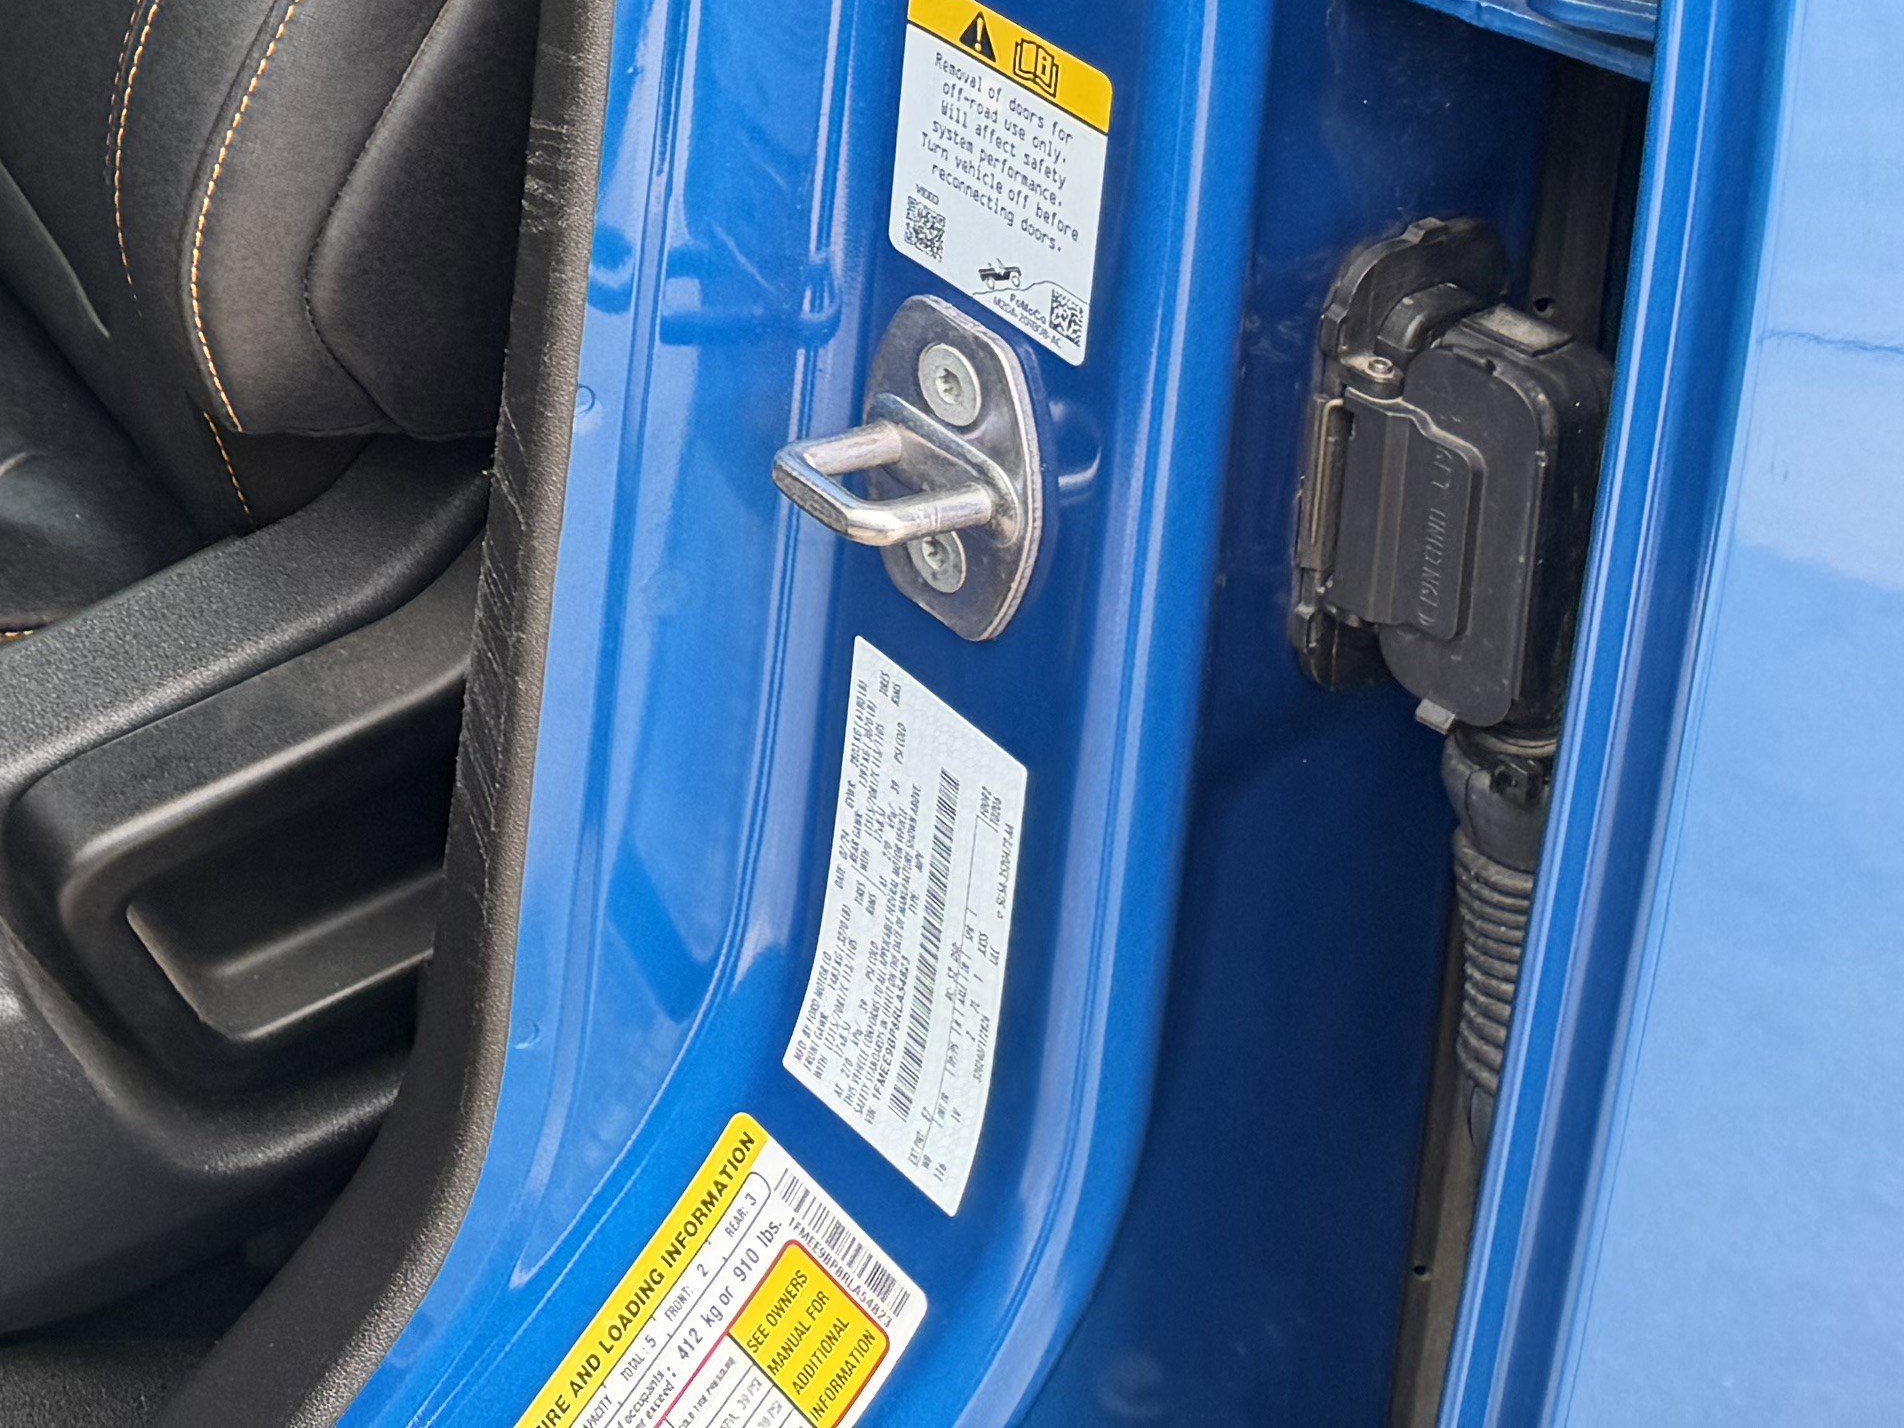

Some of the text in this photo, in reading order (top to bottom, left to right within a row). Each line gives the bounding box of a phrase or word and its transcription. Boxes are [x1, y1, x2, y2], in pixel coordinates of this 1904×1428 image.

[935, 52, 1073, 143] Removal of doors for
[942, 82, 1066, 164] off-road use only.
[932, 120, 1062, 206] system performance.
[941, 99, 1066, 190] Will affect safety
[922, 131, 1078, 242] Turn vehicle off before
[932, 164, 1061, 252] reconnecting doors.
[905, 815, 917, 850] SHOWN
[898, 851, 913, 917] MANUFACTURE
[842, 806, 908, 1106] THIS VEHICLE CONFORMS TO ALL APPLICABLE FEDERAL MOTOR VEHICLE
[892, 928, 903, 954] DATE
[805, 998, 820, 1025] FORD
[813, 964, 829, 999] MOTOR
[881, 986, 894, 1018] EFFECT
[803, 1039, 819, 1072] FRONT
[813, 1054, 828, 1080] WITH
[833, 1082, 844, 1098] AT
[864, 1026, 886, 1083] STANDARDS
[853, 1082, 870, 1115] SAFETY
[569, 1354, 600, 1398] AND
[598, 1268, 664, 1353] LOADING
[661, 1132, 754, 1267] INFORMATION
[644, 1334, 656, 1348] 5
[664, 1286, 693, 1322] FRONT:
[696, 1263, 709, 1277] 2
[724, 1206, 748, 1238] REAR:
[744, 1192, 757, 1206] 3
[677, 1327, 703, 1359] 412
[700, 1305, 723, 1327] kg
[718, 1285, 733, 1306] or
[732, 1247, 759, 1282] 910
[756, 1221, 782, 1247] lbs.
[746, 1269, 807, 1353] SEE OWNERS
[766, 1290, 829, 1376] MANUAL FOR
[792, 1318, 849, 1395] ADDITIONAL
[810, 1329, 875, 1421] INFORMATION
